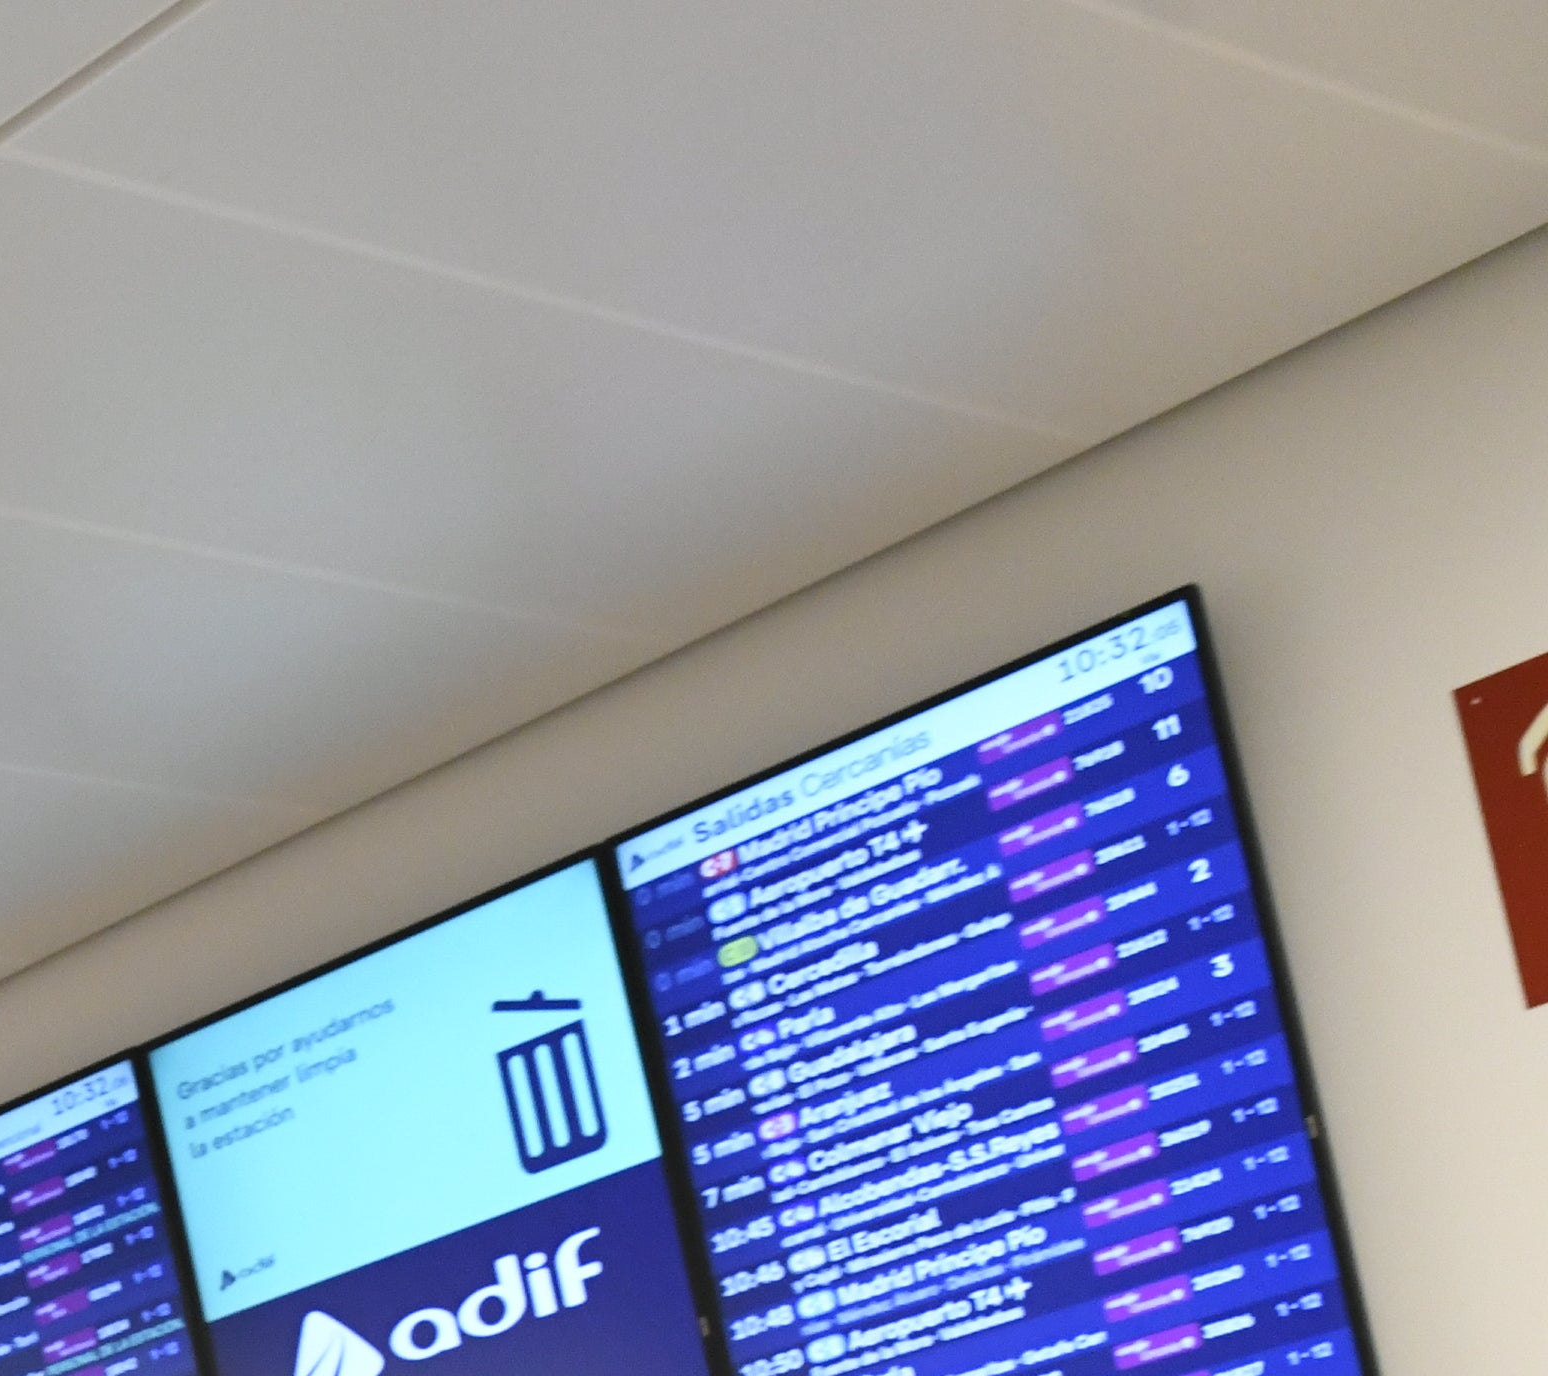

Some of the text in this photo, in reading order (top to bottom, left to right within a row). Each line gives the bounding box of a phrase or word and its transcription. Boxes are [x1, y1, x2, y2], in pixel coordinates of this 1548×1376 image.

[692, 790, 794, 843] Salidas
[799, 731, 930, 797] Cercanías
[737, 818, 813, 863] Madrid
[1139, 666, 1173, 693] 10
[749, 847, 869, 907] Aeropuerto
[867, 830, 901, 856] T4
[1152, 714, 1181, 740] 11
[755, 763, 1190, 950] Villalba de Guadarr. 6
[664, 941, 878, 1036] 1 min Cercedilla
[673, 857, 1211, 1079] 2 min Parla 2
[176, 999, 394, 1100] Gracias por ayudarnos
[184, 1047, 357, 1129] a mantener limpia
[683, 1024, 916, 1122] 5 min Guadalajara
[693, 952, 1234, 1165] 5 min Aranjuez 3
[189, 1107, 292, 1159] la estación
[702, 1101, 973, 1208] 7 min Colmenar Viejo
[712, 1215, 775, 1252] 10:45
[818, 1122, 1059, 1215] Alcobendas-S.S.Reyes
[391, 1229, 600, 1359] adif
[721, 1207, 941, 1296] 10:46 El Escorial
[836, 1264, 915, 1305] Madrid
[847, 1299, 971, 1350] Aeropuerto
[968, 1285, 1004, 1311] T4
